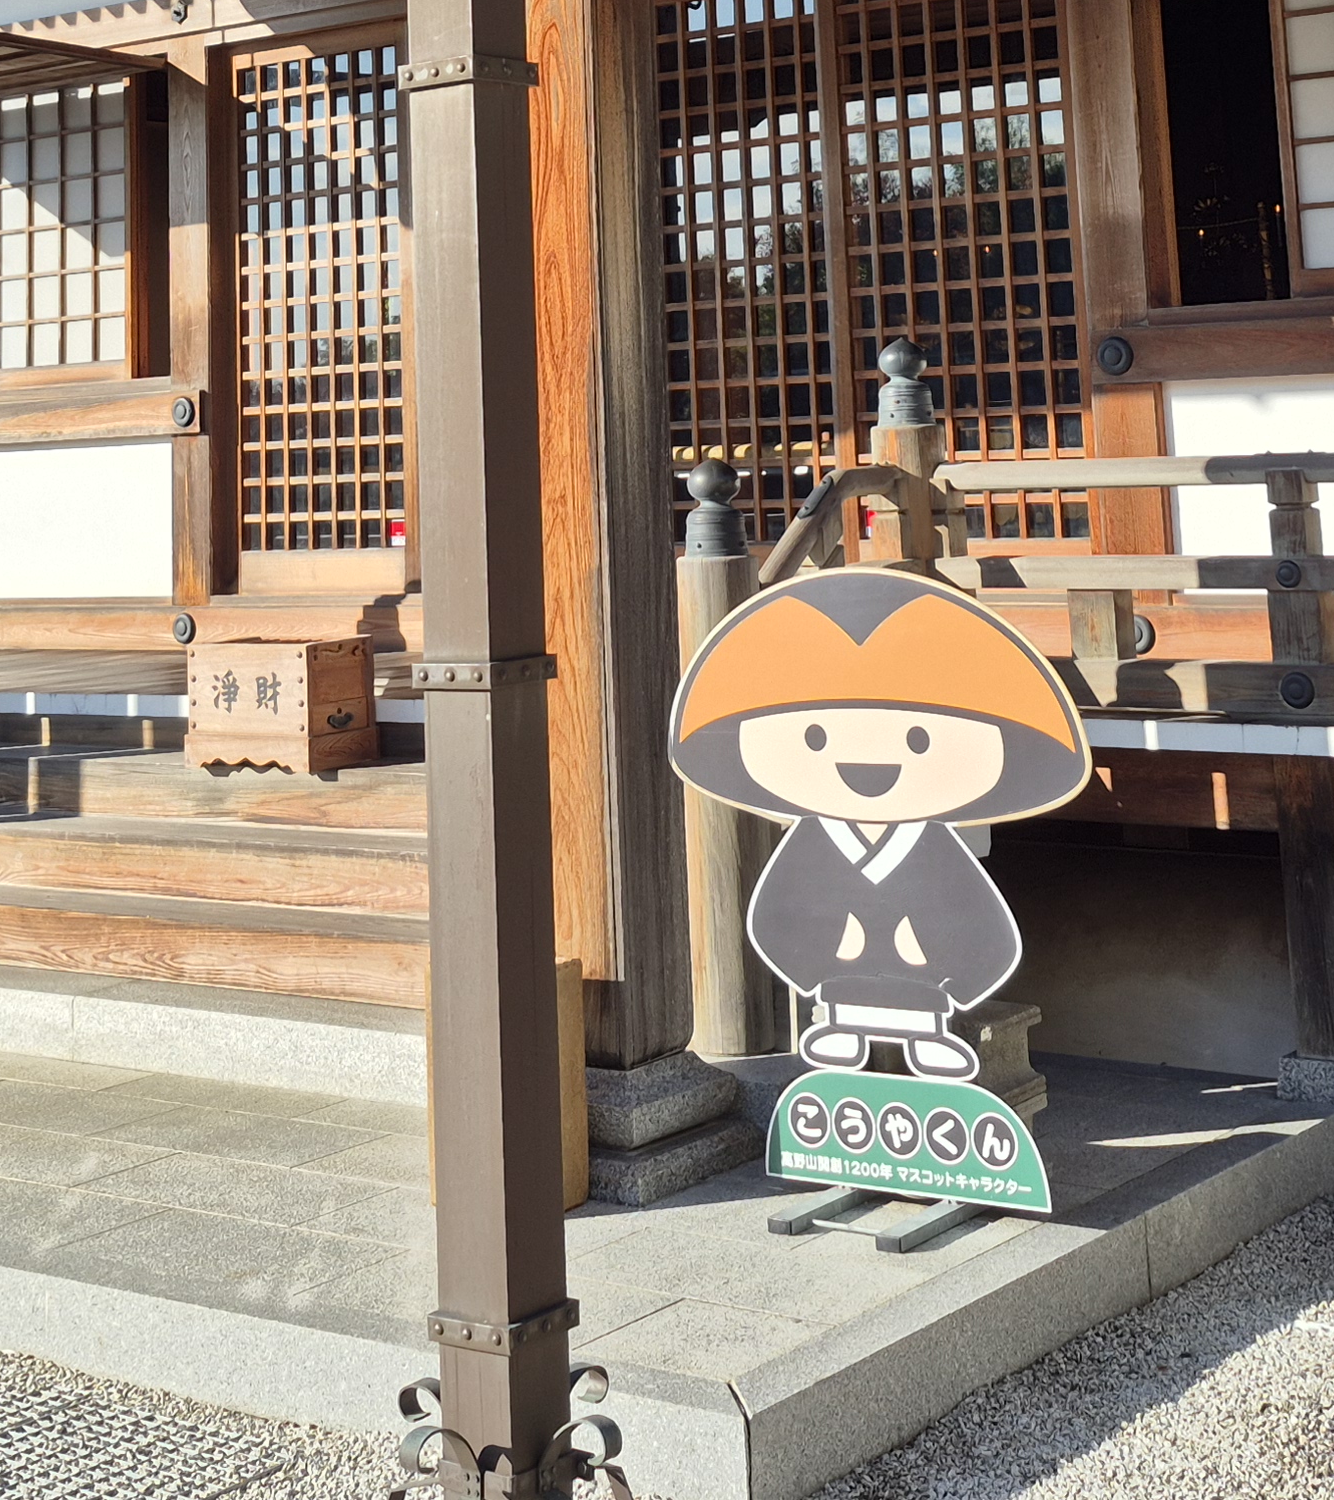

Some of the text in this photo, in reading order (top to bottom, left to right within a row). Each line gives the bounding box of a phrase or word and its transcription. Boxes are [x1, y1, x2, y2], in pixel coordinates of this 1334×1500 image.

[796, 1102, 1010, 1164] こうやくん
[780, 1150, 1033, 1196] 高野山開創1200年 マスコットキャラクター
